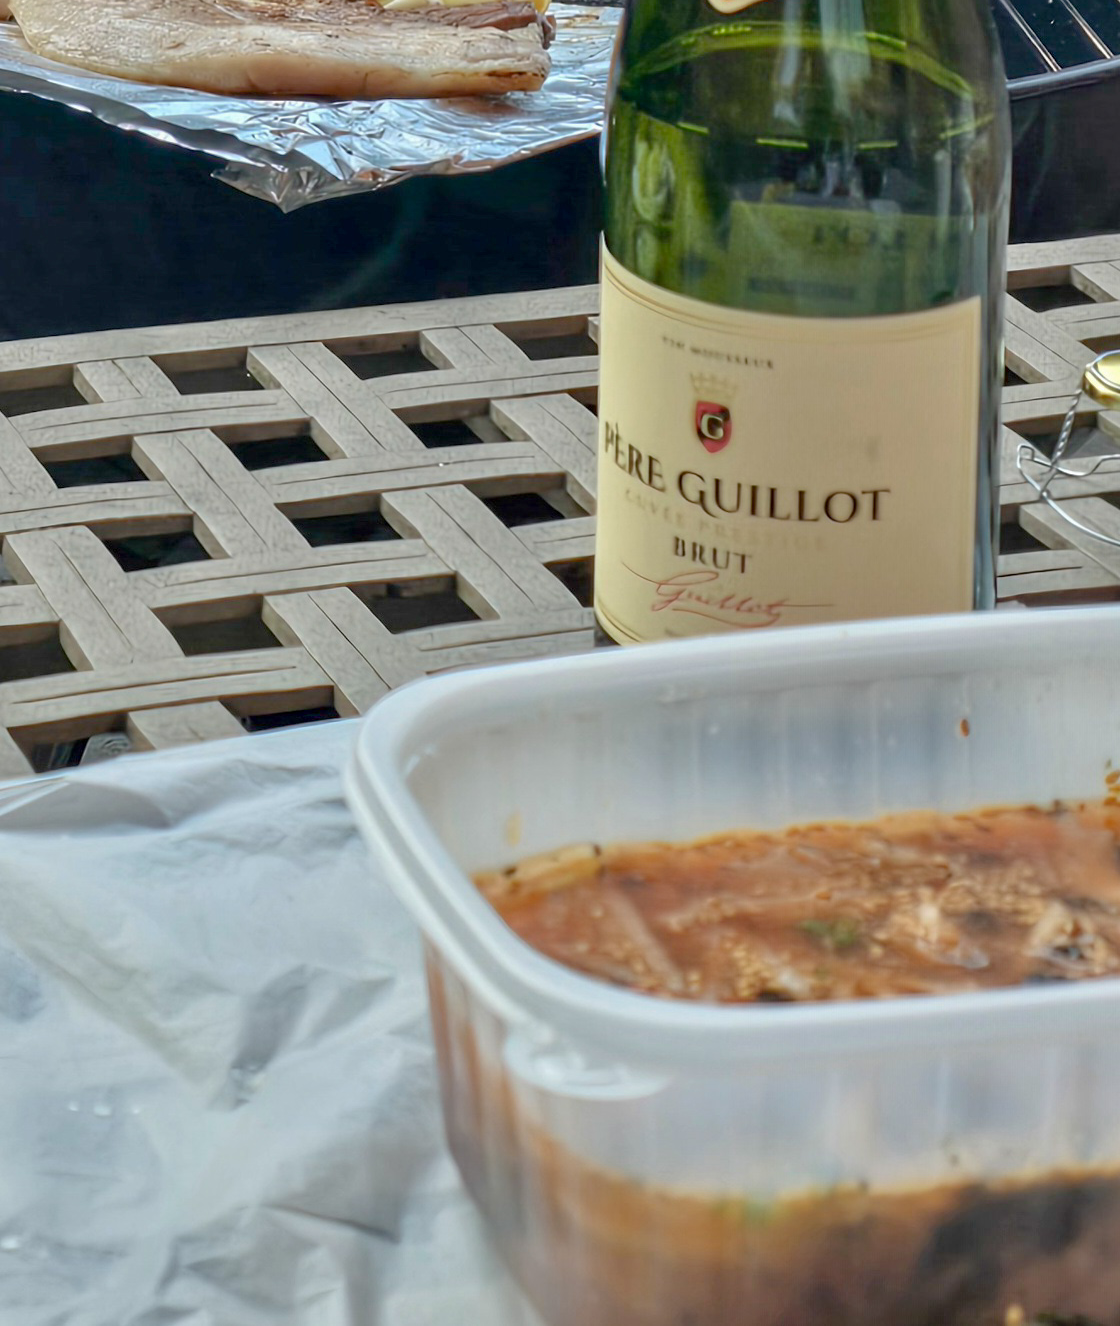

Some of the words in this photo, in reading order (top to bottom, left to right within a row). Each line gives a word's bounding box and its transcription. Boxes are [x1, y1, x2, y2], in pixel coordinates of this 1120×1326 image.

[604, 420, 667, 494] PÈRE
[676, 469, 892, 524] GUILLOT
[673, 535, 753, 575] BRUT
